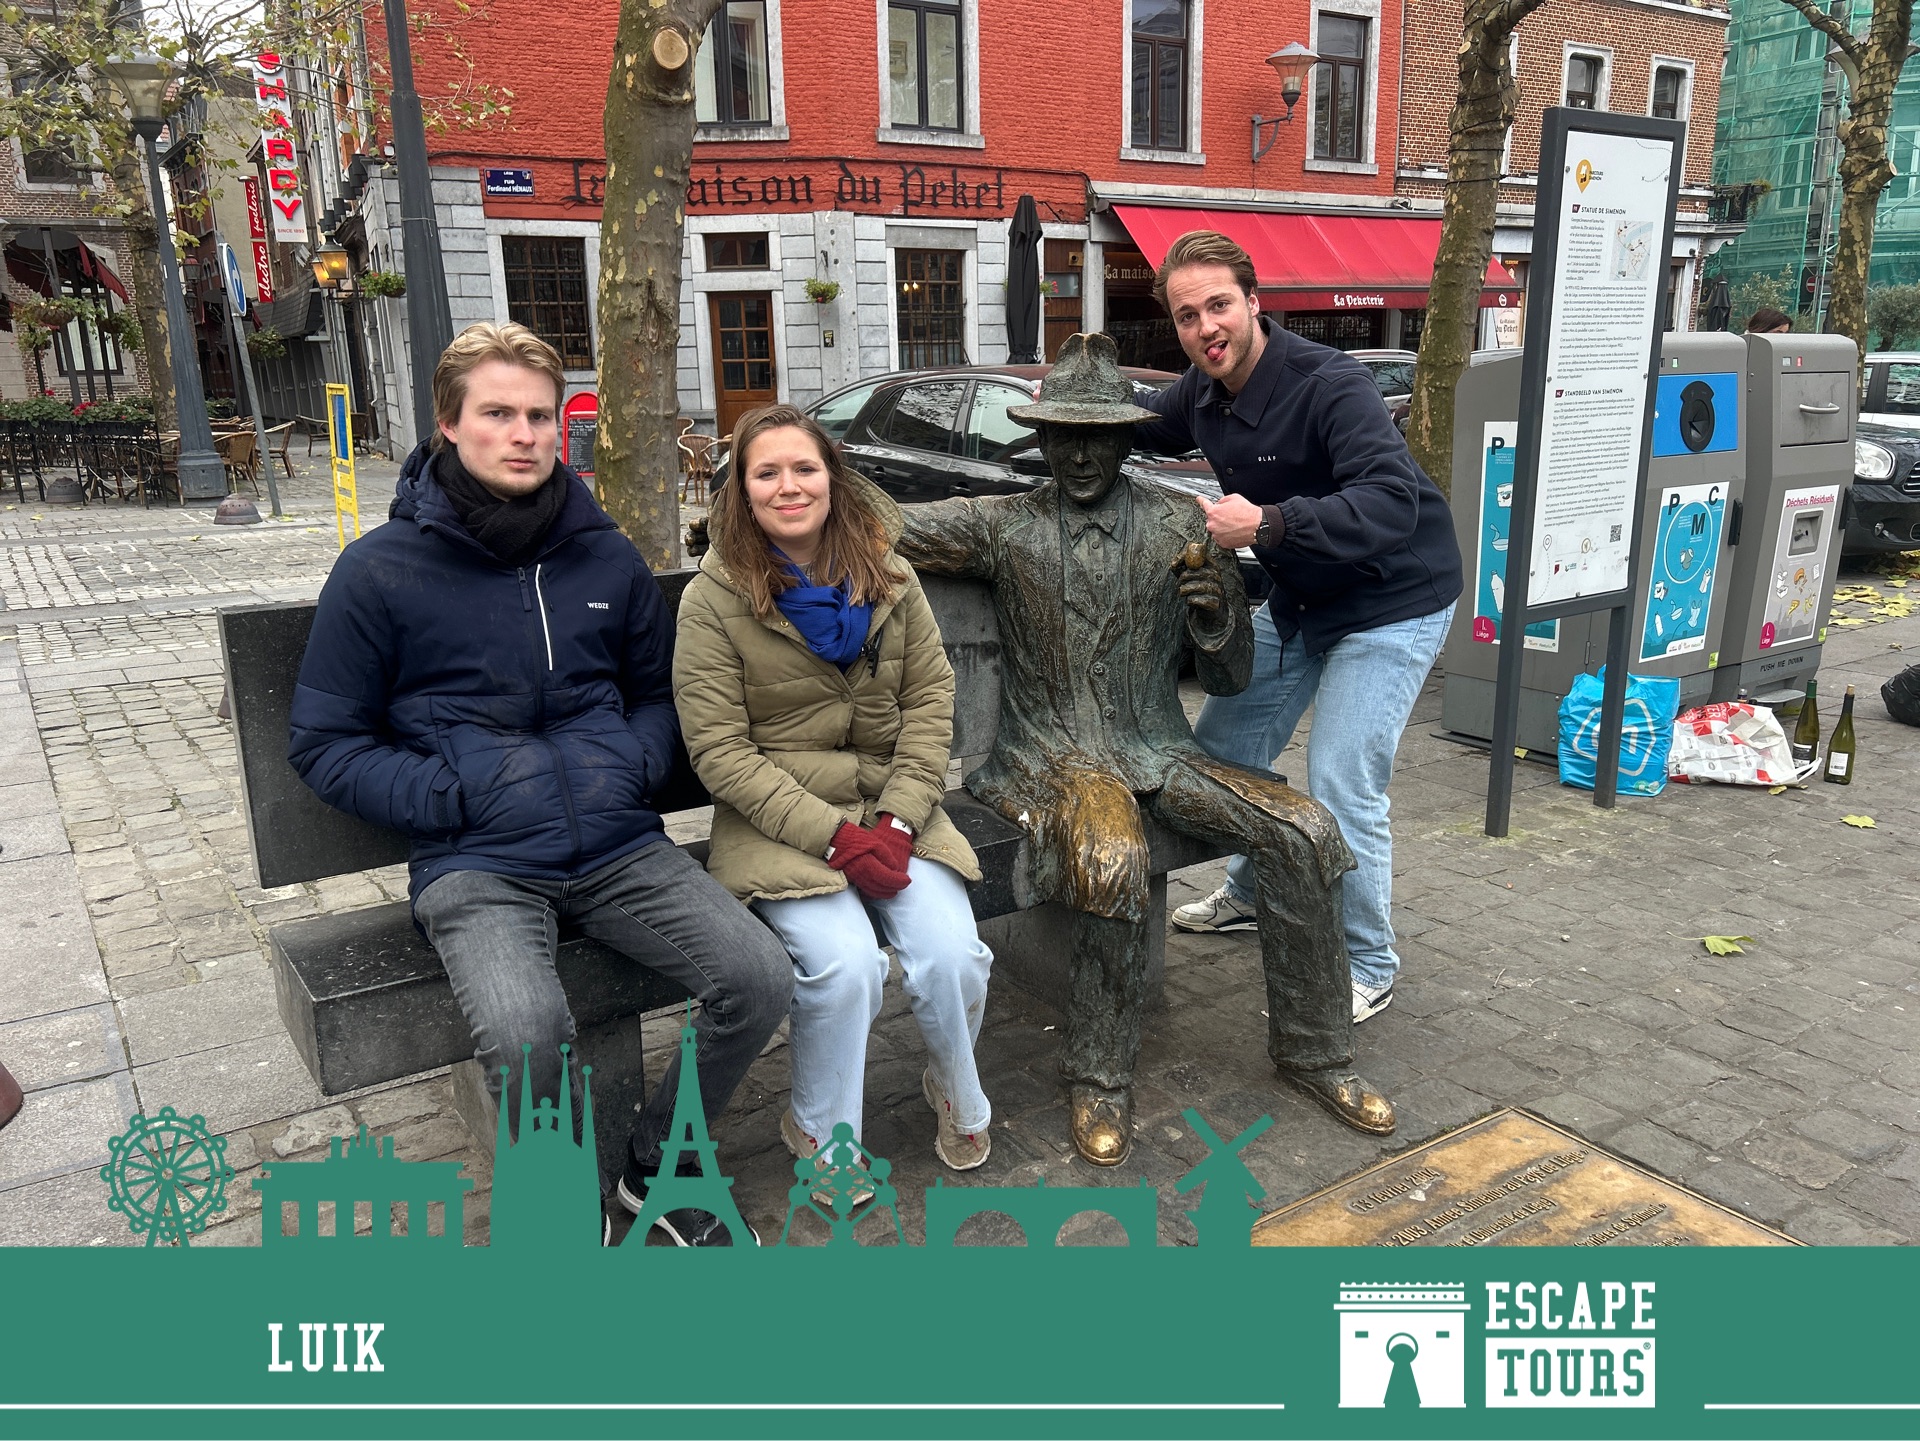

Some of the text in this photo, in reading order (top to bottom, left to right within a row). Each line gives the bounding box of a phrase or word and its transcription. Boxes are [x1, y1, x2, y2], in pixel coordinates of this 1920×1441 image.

[487, 184, 512, 192] Ferdinand
[687, 165, 814, 206] aison
[836, 161, 881, 204] du
[900, 165, 1004, 216] Peket
[1581, 206, 1597, 214] STATUE
[258, 245, 271, 299] electro
[1104, 264, 1154, 280] La maiso
[1333, 294, 1385, 308] La Peketerie
[1564, 389, 1592, 397] STANDBEELD
[1491, 436, 1505, 456] P
[1708, 485, 1720, 506] C
[1786, 494, 1835, 508] Déchets Résiduels
[1668, 493, 1681, 516] P
[1691, 512, 1706, 536] M
[1475, 630, 1490, 639] Liège
[1760, 656, 1804, 673] PUSH ME DOWN
[1351, 1199, 1375, 1213] 13
[1405, 1167, 1441, 1187] 2004
